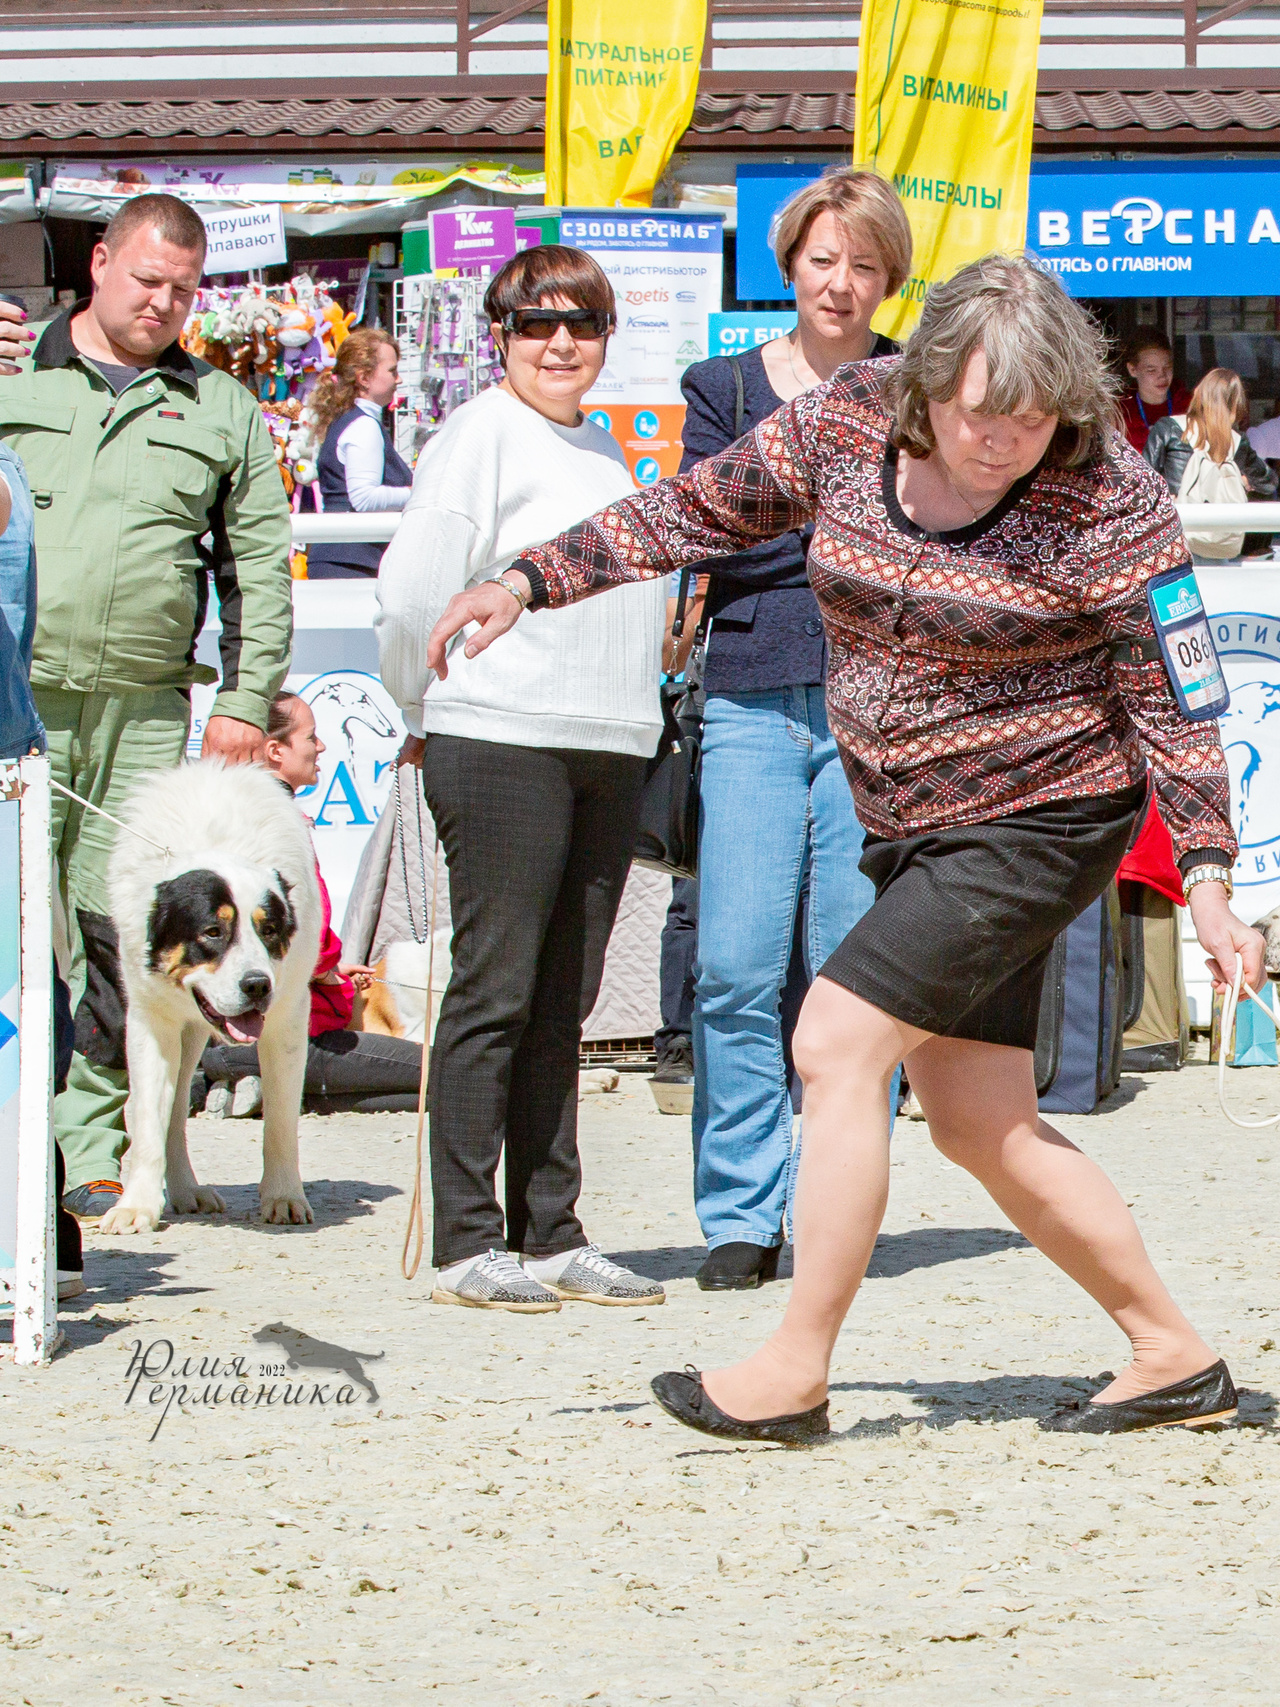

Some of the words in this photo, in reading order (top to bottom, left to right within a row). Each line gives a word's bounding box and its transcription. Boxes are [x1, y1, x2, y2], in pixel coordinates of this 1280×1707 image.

[903, 74, 1008, 112] ВИТАМИНЫ
[893, 173, 1003, 210] МИНЕРАЛЫ
[604, 264, 621, 274] ЫЙ
[623, 266, 707, 276] ДИСТРИБЬЮТОР
[1095, 257, 1109, 272] О
[1112, 256, 1192, 272] ГЛАВНОМ
[625, 287, 670, 306] zoetis
[719, 327, 748, 345] ОТ
